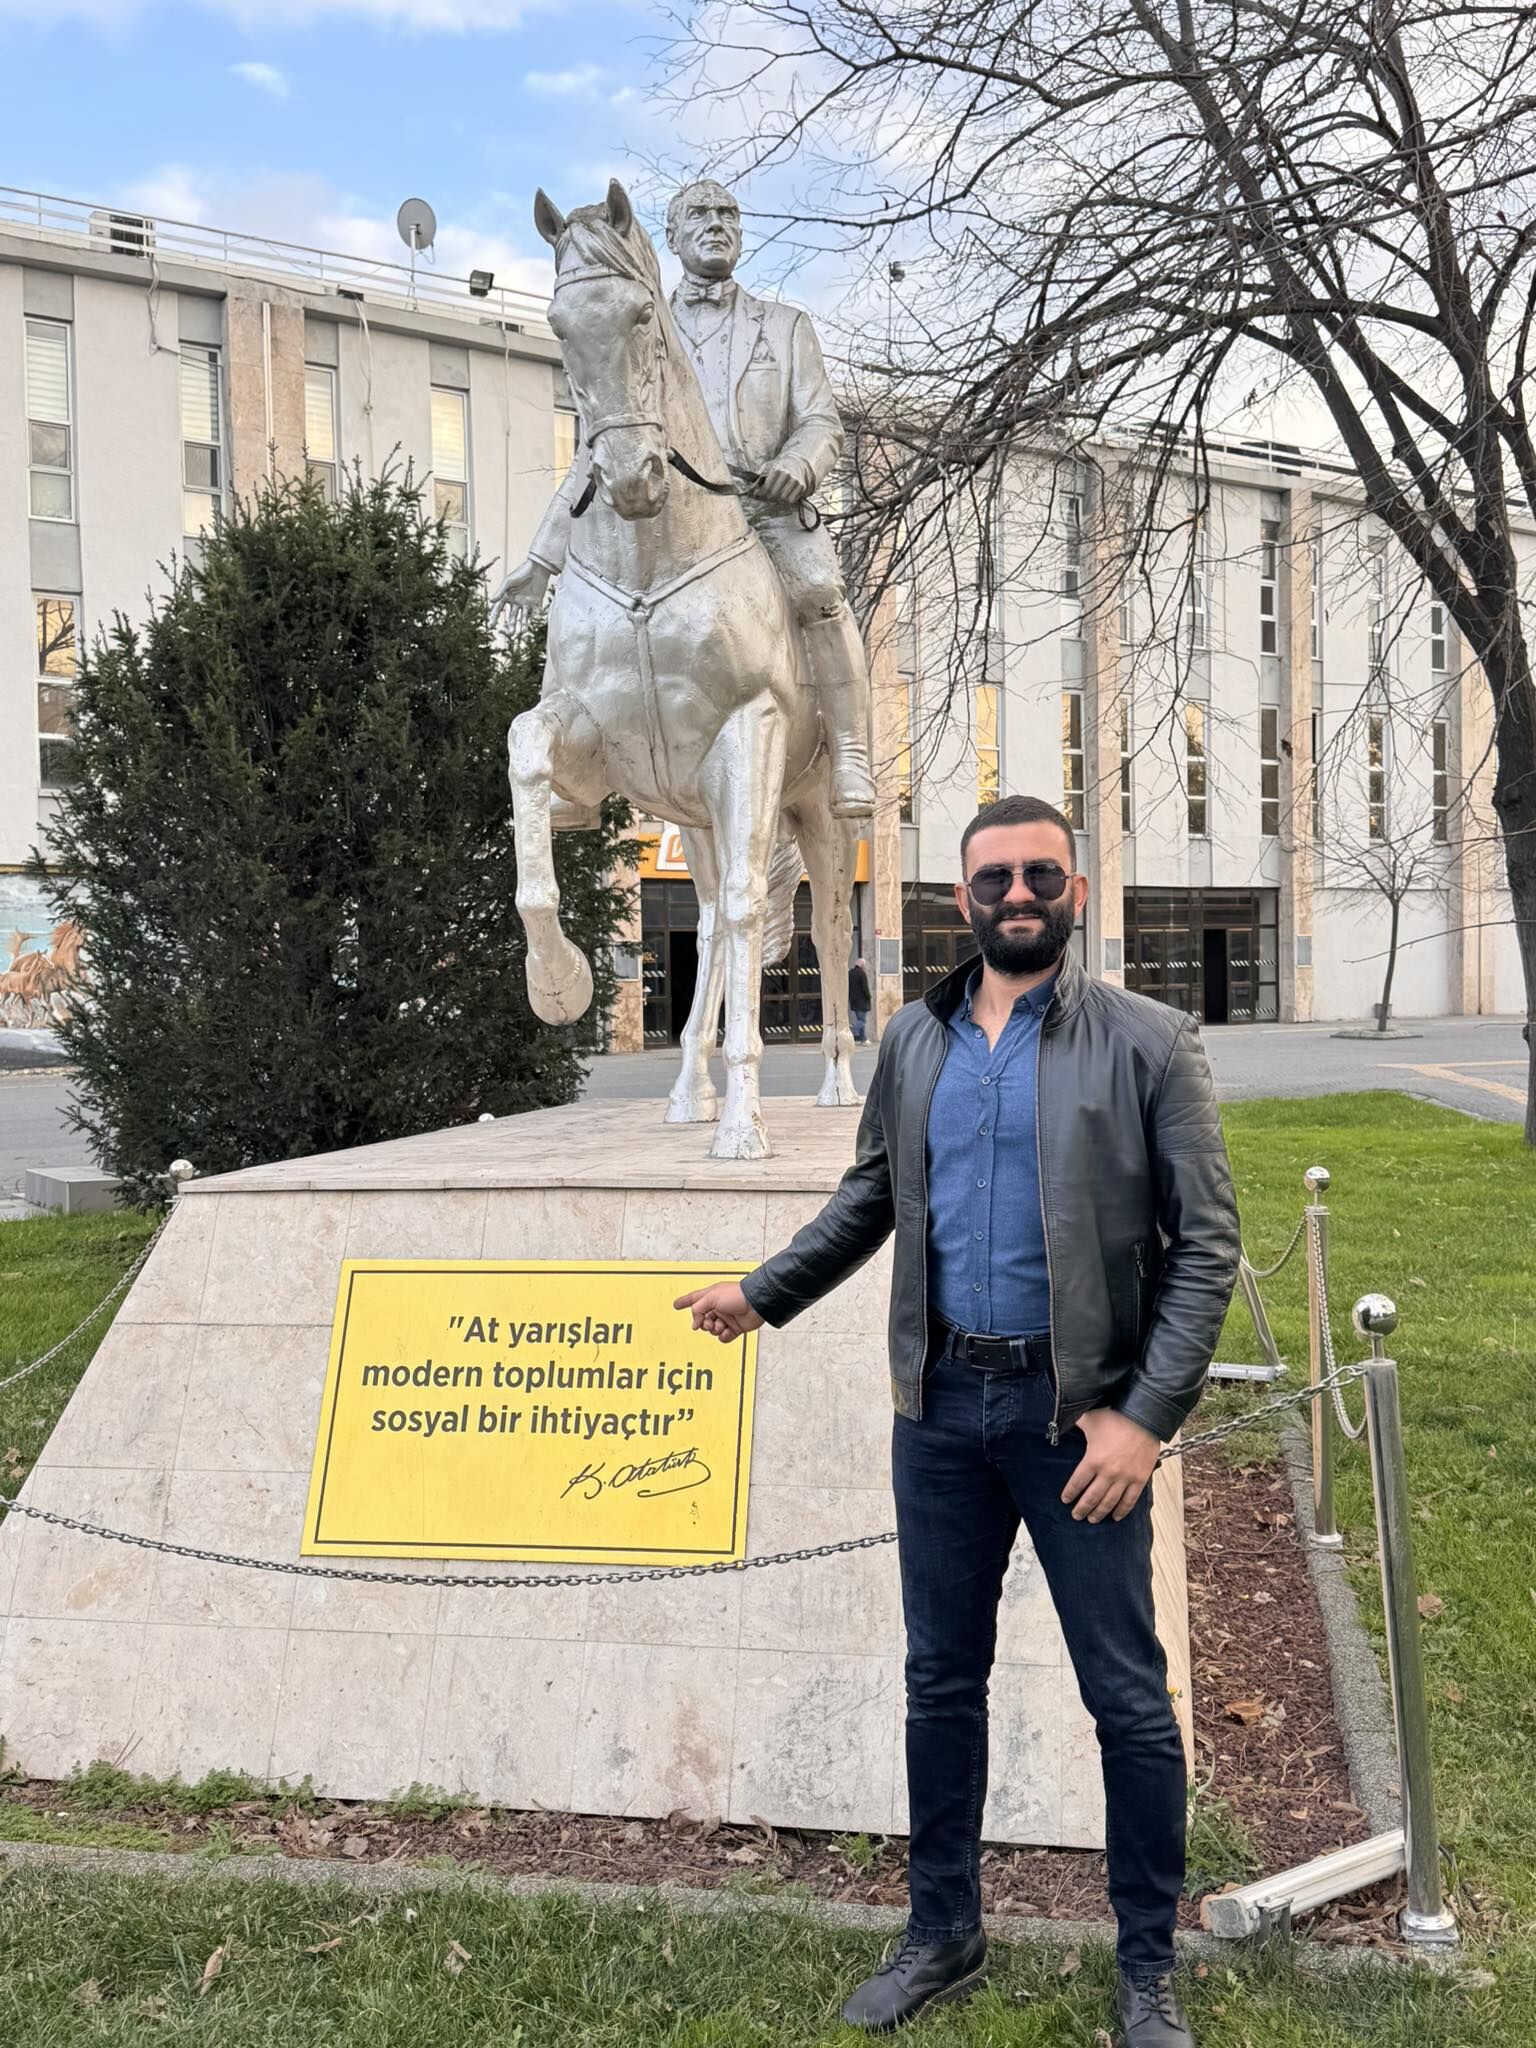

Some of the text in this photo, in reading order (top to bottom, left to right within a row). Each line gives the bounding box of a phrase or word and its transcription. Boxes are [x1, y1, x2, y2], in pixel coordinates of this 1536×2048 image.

[508, 1316, 633, 1349] yarışları
[361, 1359, 713, 1396] modern toplumlar için
[371, 1404, 469, 1438] sosyal
[478, 1404, 522, 1433] bir
